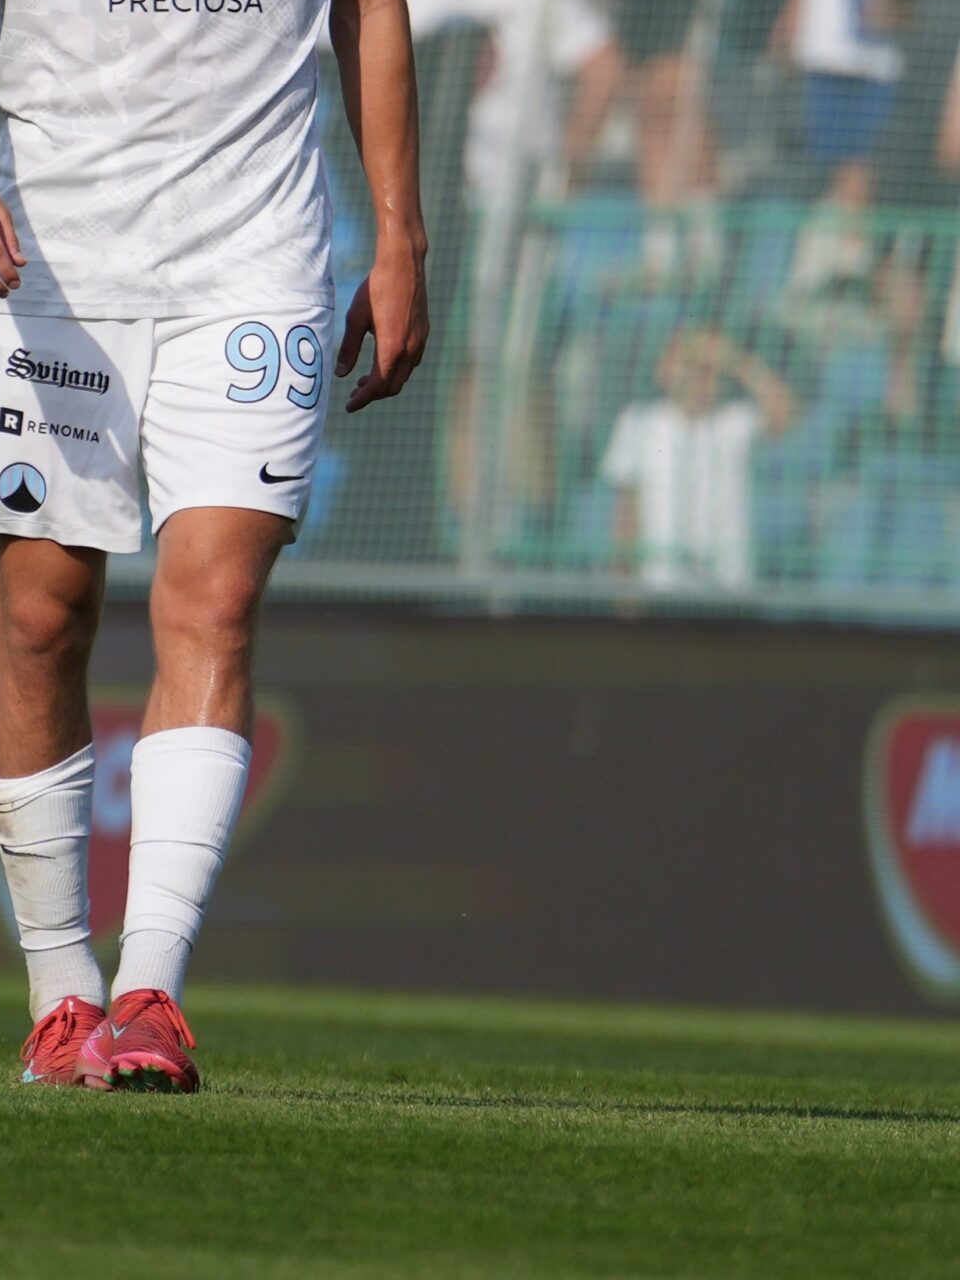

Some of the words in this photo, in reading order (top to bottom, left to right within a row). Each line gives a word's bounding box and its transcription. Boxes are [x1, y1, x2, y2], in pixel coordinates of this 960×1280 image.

[5, 347, 110, 395] Svijany
[224, 320, 323, 410] 99
[27, 420, 100, 443] RENOMIA
